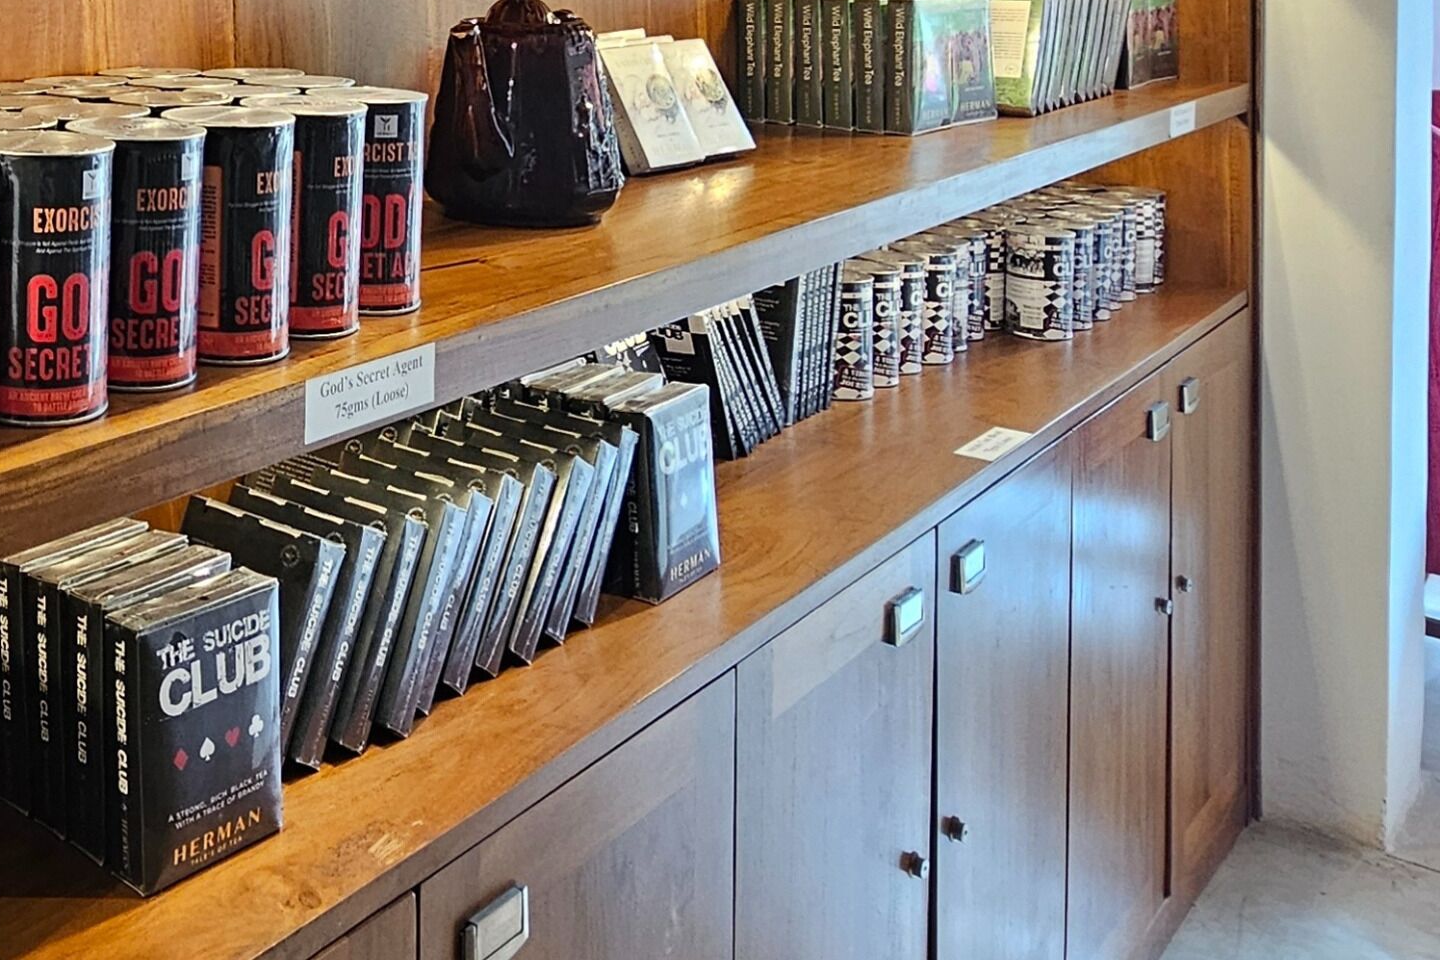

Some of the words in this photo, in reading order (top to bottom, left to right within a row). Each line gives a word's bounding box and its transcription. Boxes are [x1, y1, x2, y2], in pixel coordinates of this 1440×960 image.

[746, 3, 755, 23] Wild
[774, 3, 783, 23] Wild
[802, 5, 811, 25] Wild
[832, 5, 840, 27] Wild
[863, 7, 872, 28] Wild
[895, 8, 905, 29] Wild
[745, 25, 755, 61] Elephant
[773, 25, 783, 61] Elephant
[802, 28, 811, 66] Elephant
[831, 28, 841, 67] Elephant
[862, 30, 873, 69] Elephant
[893, 31, 905, 70] Elephant
[746, 63, 755, 77] Tea
[773, 63, 783, 78] Tea
[803, 66, 812, 81] Tea
[832, 67, 842, 82] Tea
[864, 70, 874, 85] Tea
[894, 71, 905, 87] Tea
[320, 376, 353, 398] God's
[356, 366, 390, 387] Secret
[393, 356, 423, 376] Agent
[335, 399, 369, 419] 75gms
[372, 383, 409, 409] (Loose)
[660, 434, 707, 475] CLUB
[627, 502, 639, 533] CLUB
[361, 547, 376, 578] THE
[404, 536, 418, 563] THE
[670, 547, 710, 581] HERMAN
[318, 558, 333, 587] THE
[509, 563, 524, 598] CLUB
[37, 595, 46, 628] THE
[344, 580, 364, 637] SUICIDE
[387, 567, 408, 626] SUICIDE
[441, 594, 455, 631] CLUB
[475, 576, 490, 612] CLUB
[77, 615, 87, 646] THE
[156, 637, 195, 669] THE
[203, 609, 270, 652] SUICIDE
[300, 591, 323, 652] SUICIDE
[417, 611, 433, 650] CLUB
[0, 614, 10, 674] SUICIDE
[37, 631, 48, 693] SUICIDE
[114, 640, 125, 673] THE
[332, 641, 349, 682] CLUB
[375, 629, 393, 667] CLUB
[77, 652, 87, 717] SUICIDE
[160, 633, 271, 718] CLUB
[288, 656, 306, 698] CLUB
[3, 679, 12, 721] CLUB
[116, 678, 127, 745] SUICIDE
[39, 699, 49, 743] CLUB
[78, 720, 87, 764] CLUB
[117, 749, 128, 795] CLUB
[168, 814, 175, 823] A
[176, 800, 208, 820] STRONG,
[210, 790, 227, 804] RICH
[231, 778, 253, 795] BLACK
[255, 770, 268, 783] TEA
[175, 816, 194, 829] WITH
[195, 812, 201, 820] A
[203, 799, 224, 816] TRACE
[226, 794, 235, 804] OF
[238, 780, 264, 800] BRANDY
[173, 808, 261, 865] HERMAN
